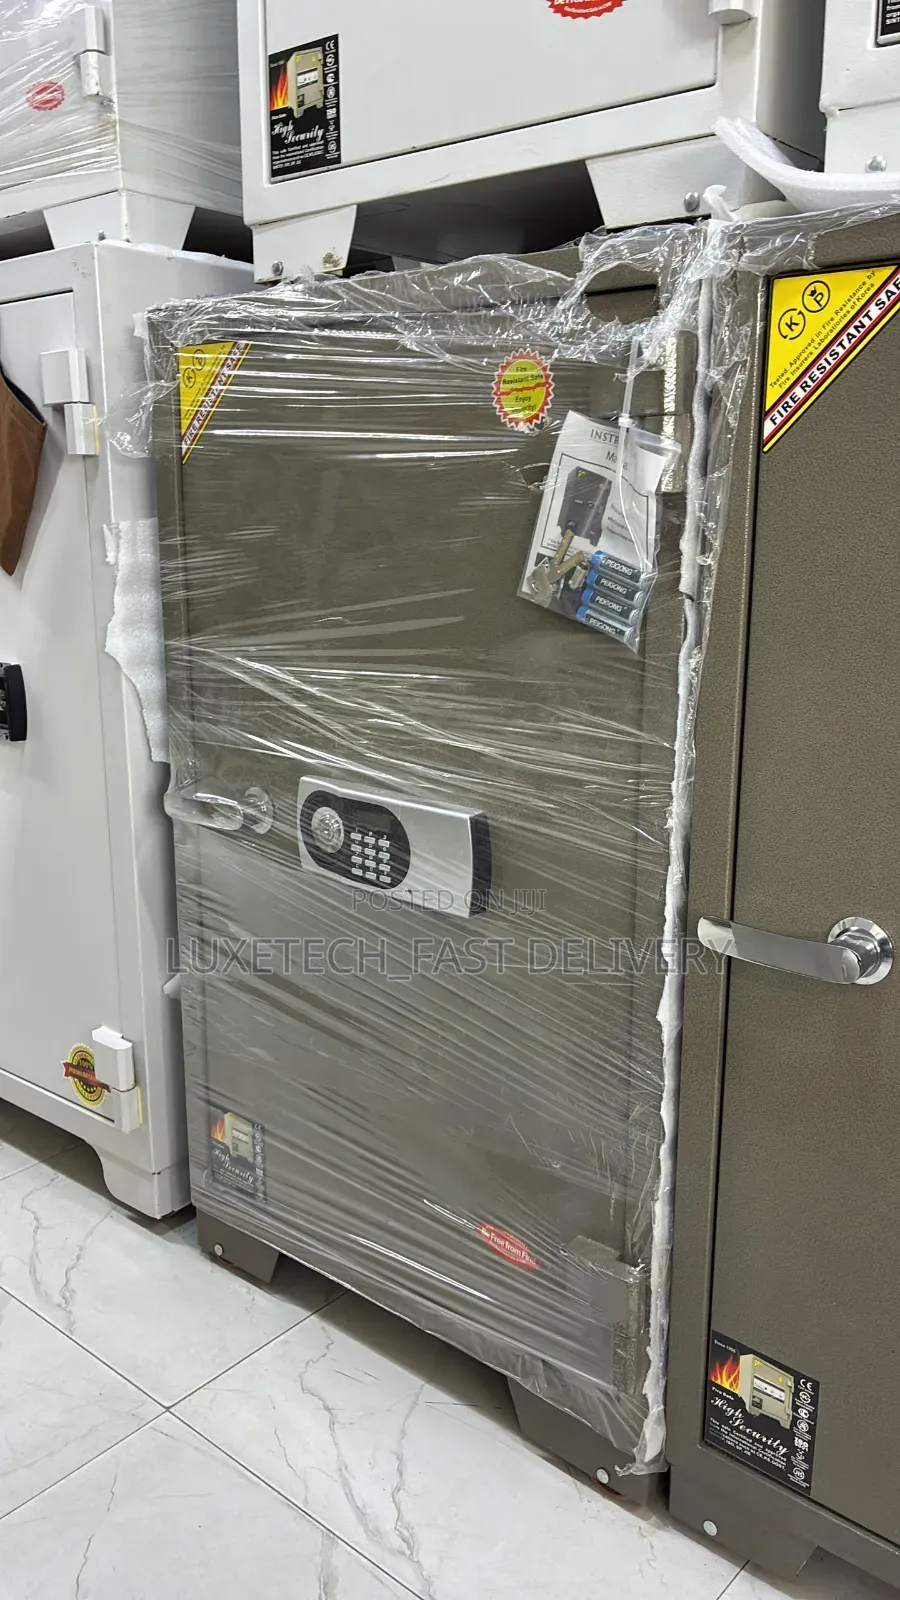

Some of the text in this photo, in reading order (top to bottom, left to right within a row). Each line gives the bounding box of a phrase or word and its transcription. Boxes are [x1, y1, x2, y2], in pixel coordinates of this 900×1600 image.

[272, 120, 294, 138] High
[284, 124, 325, 144] Security
[789, 338, 816, 368] Approved
[814, 330, 823, 338] in
[822, 316, 835, 330] Fire
[834, 280, 867, 316] Resistance
[866, 270, 876, 280] by
[778, 376, 790, 388] Fire
[790, 351, 814, 376] Insurers
[856, 283, 875, 302] Korea
[770, 277, 900, 426] FIRE RESISTANT SAF
[184, 424, 198, 446] FIRE
[197, 372, 228, 423] RESISTNT
[590, 429, 620, 445] INSTR
[490, 1232, 504, 1246] Free
[505, 1241, 522, 1256] from
[712, 1386, 722, 1395] Fire
[800, 1378, 812, 1391] CE
[710, 1397, 744, 1417] High
[729, 1416, 790, 1456] Security
